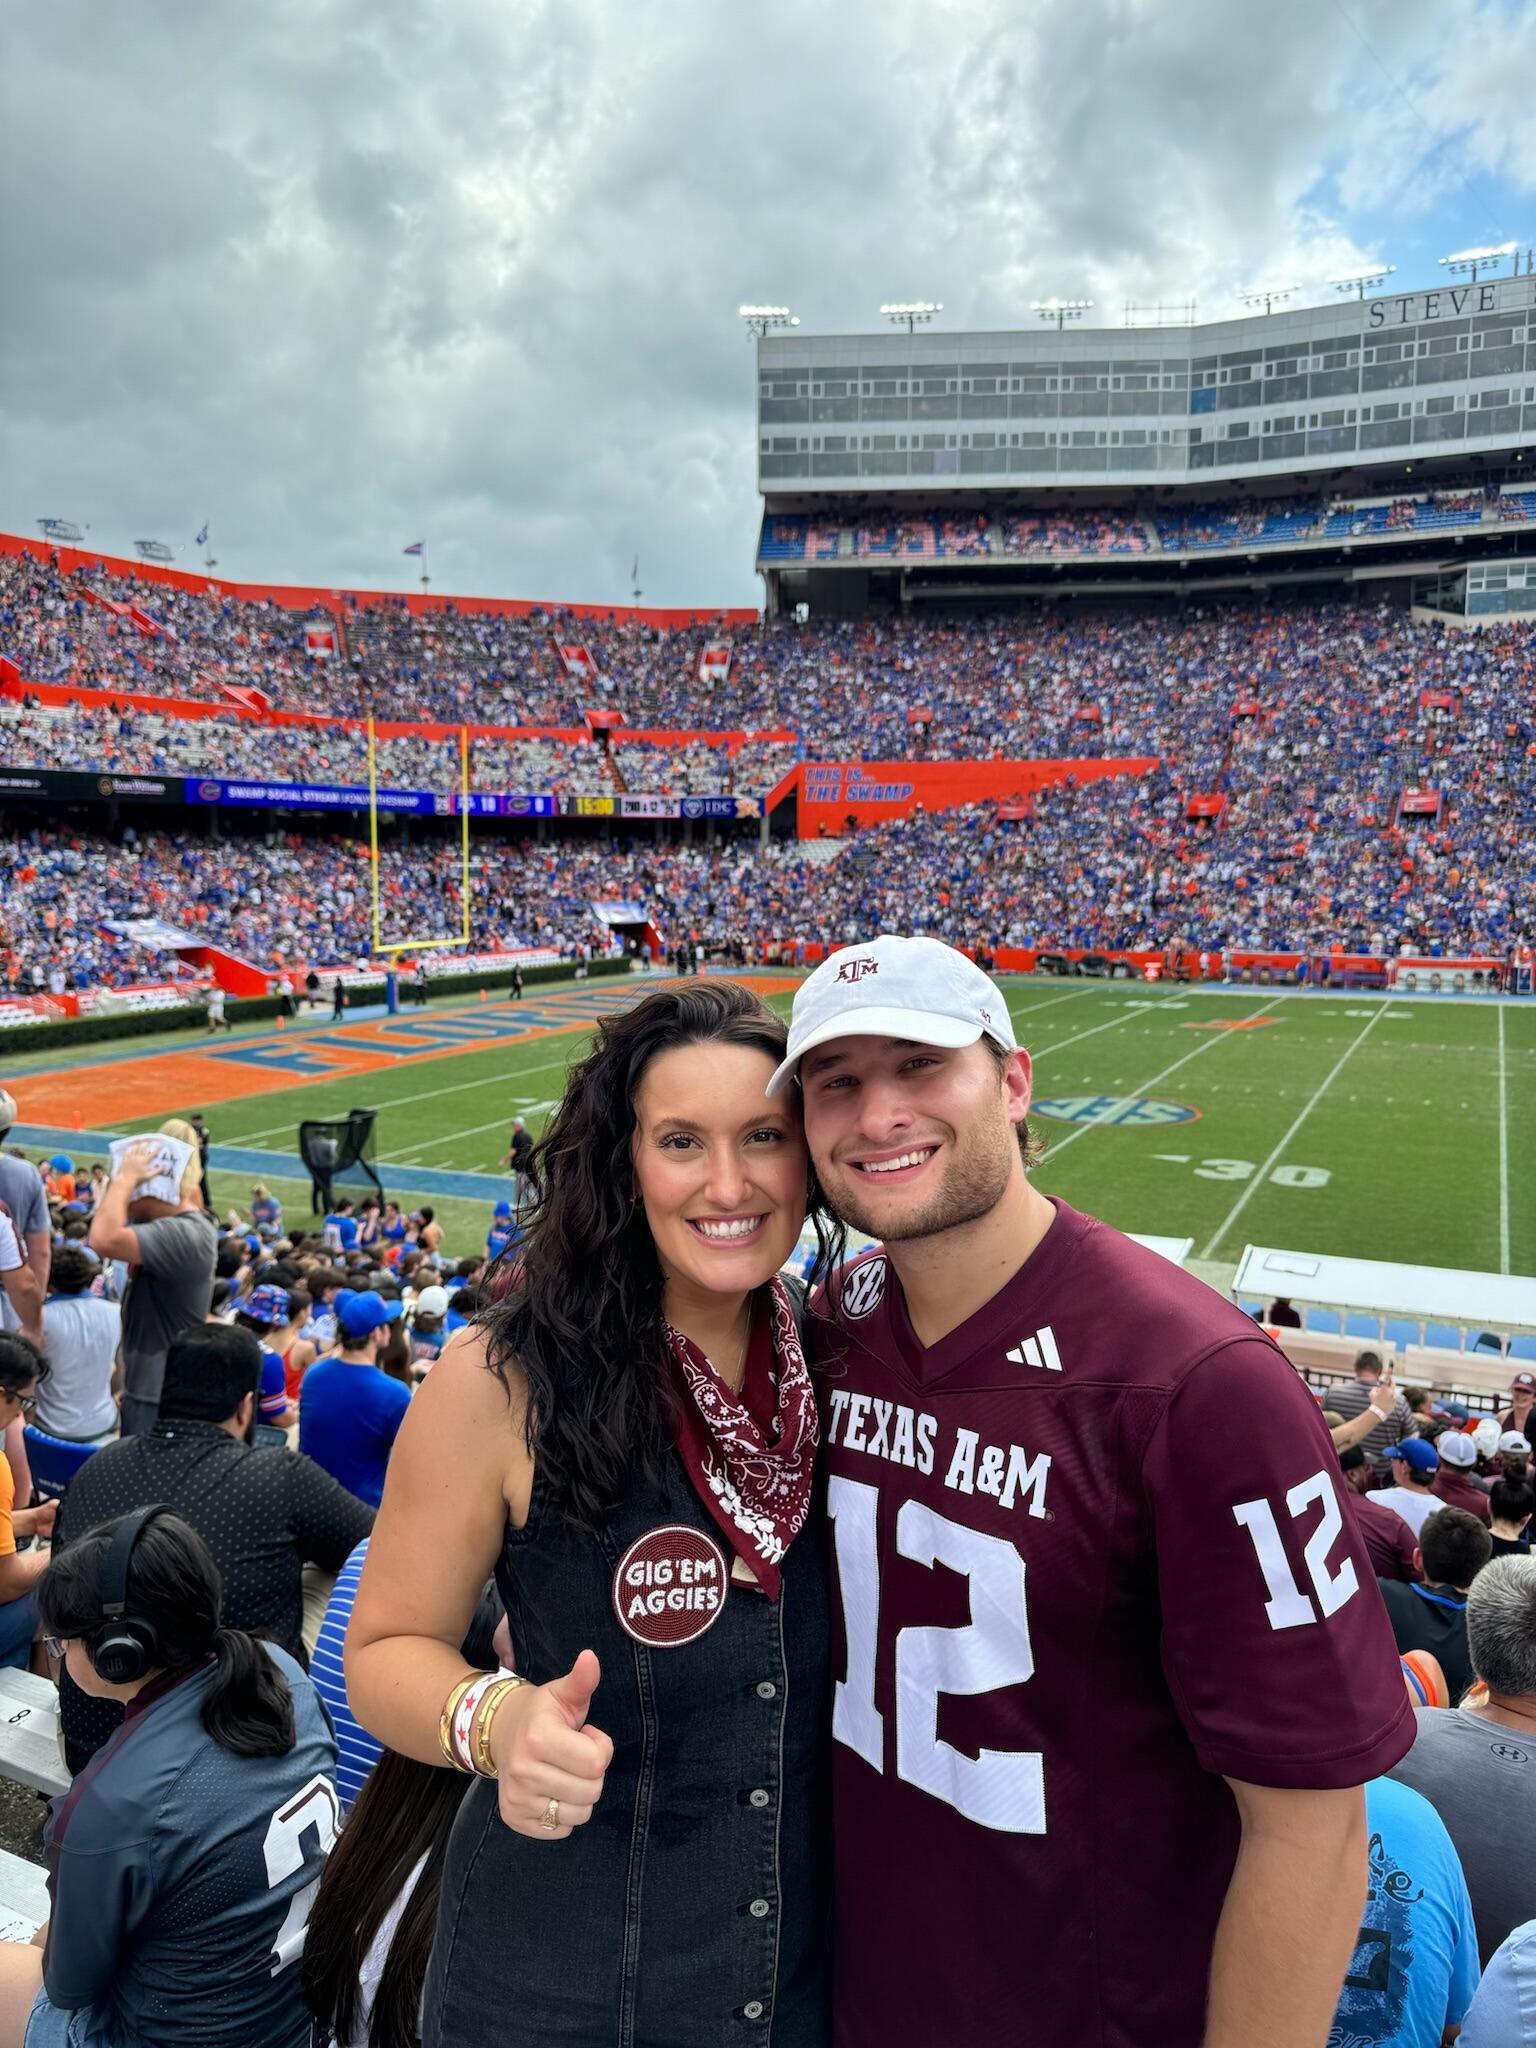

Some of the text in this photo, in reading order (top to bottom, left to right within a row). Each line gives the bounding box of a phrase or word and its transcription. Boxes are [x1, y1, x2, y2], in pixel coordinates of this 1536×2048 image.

[1369, 284, 1496, 328] STEVE
[806, 767, 841, 782] THIS
[705, 801, 732, 813] IDC
[805, 783, 913, 802] THE SWAMP
[1193, 1158, 1332, 1188] 30
[844, 1260, 886, 1314] SEC
[828, 1389, 938, 1476] TEXAS
[944, 1427, 1052, 1520] A&M
[1232, 1470, 1360, 1630] 12
[626, 1557, 717, 1586] GIG 'EM
[628, 1586, 719, 1619] AGGIES
[106, 1657, 129, 1673] JB
[827, 1474, 1047, 1834] 12
[8, 1709, 31, 1723] 8
